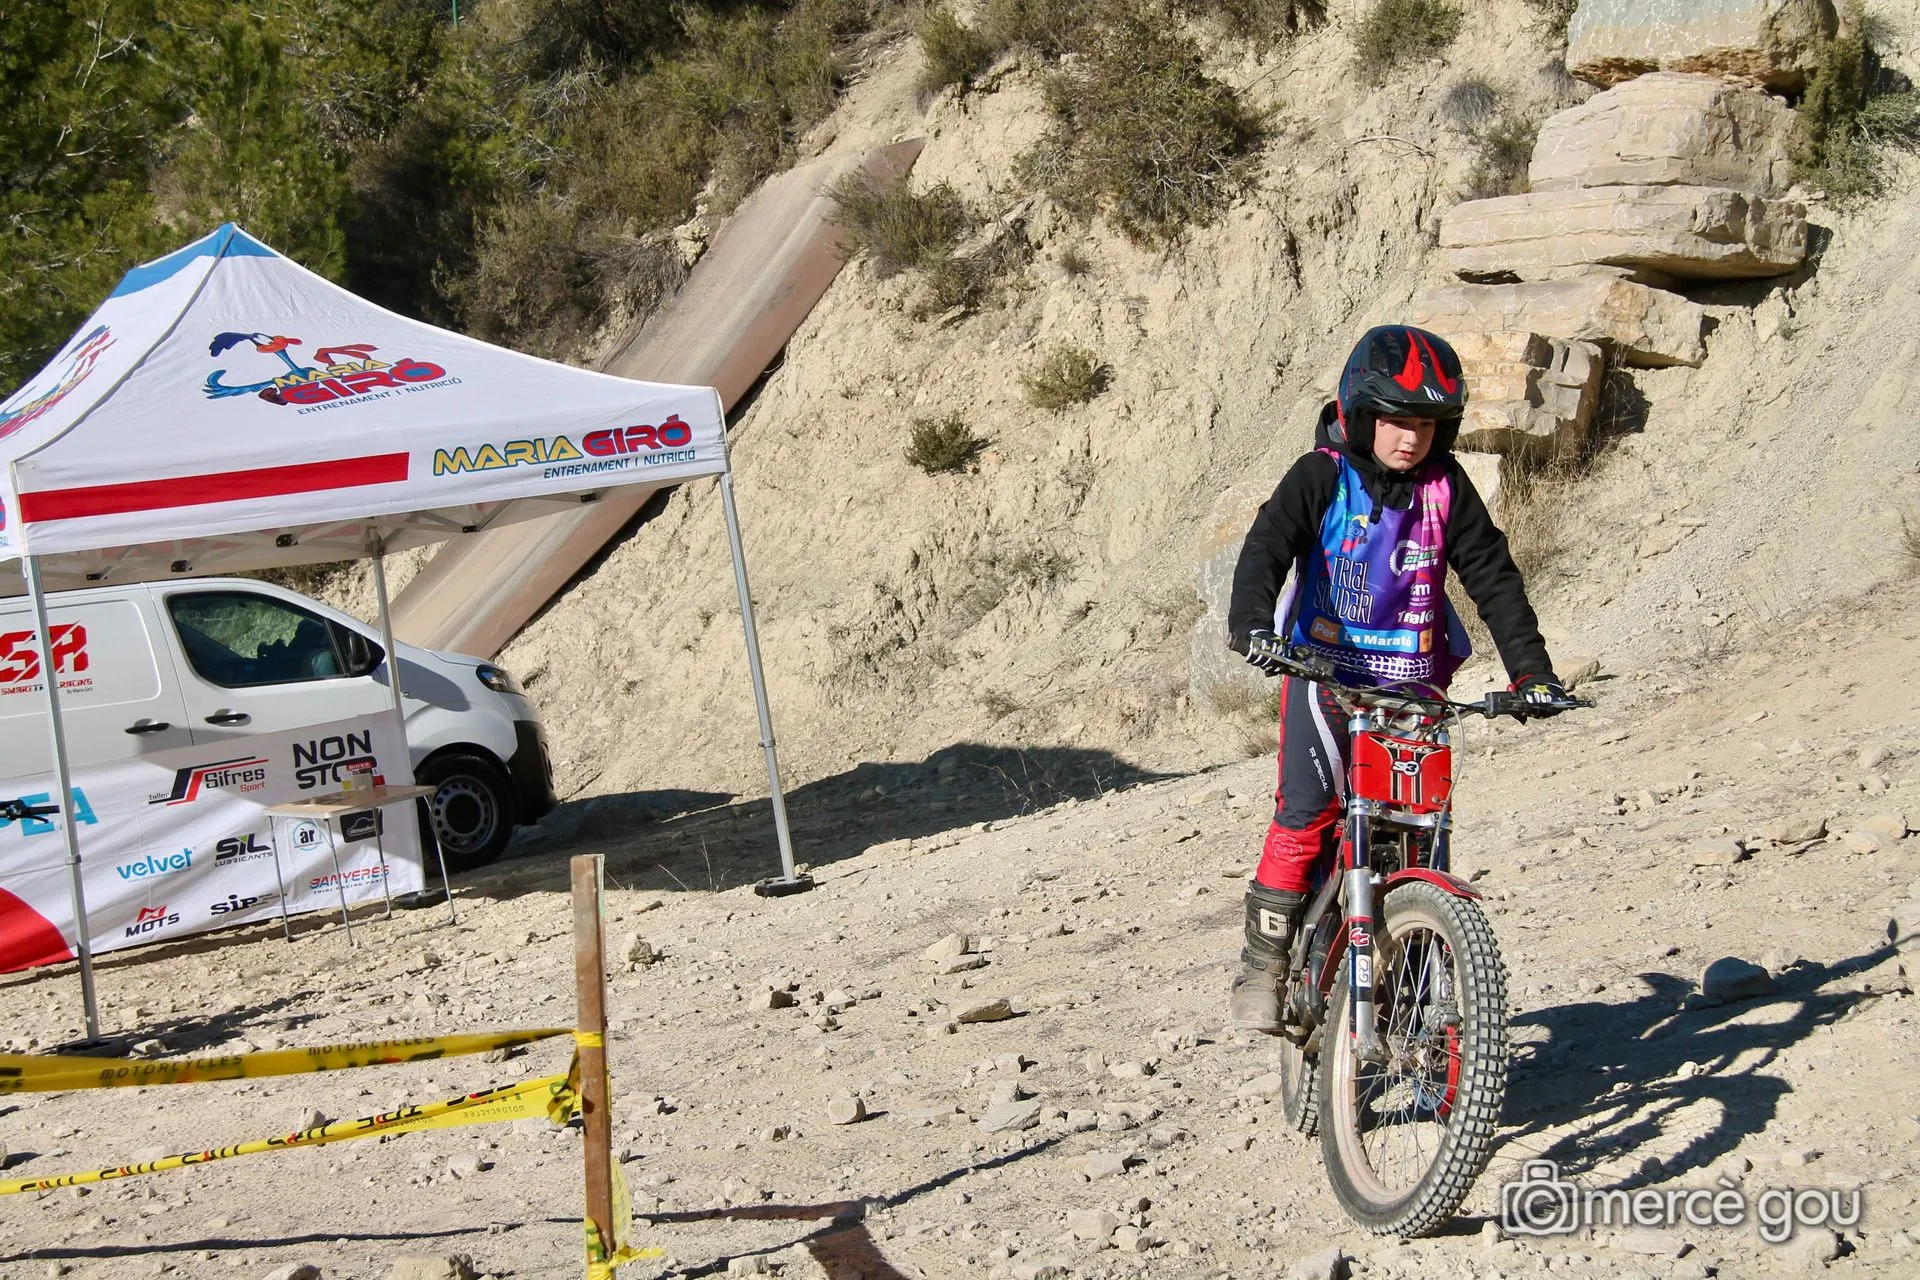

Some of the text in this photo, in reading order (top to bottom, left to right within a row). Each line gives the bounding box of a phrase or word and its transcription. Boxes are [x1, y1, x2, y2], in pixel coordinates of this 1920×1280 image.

[273, 359, 392, 388] MARIA
[297, 391, 392, 415] ENTRENAMENT
[406, 376, 463, 394] NUTRICIÓ
[433, 413, 693, 476] MARIA GIRÓ
[543, 457, 630, 479] ENTRENAMENT
[643, 446, 696, 466] NUTRICIÓ
[1314, 622, 1335, 638] Per
[1344, 632, 1412, 648] La Marató
[292, 729, 372, 768] NON
[204, 767, 265, 789] Sifres
[240, 781, 265, 793] Sport
[1313, 758, 1329, 792] SPECIAL
[116, 848, 193, 880] velvet
[215, 851, 274, 867] LUBRICANTS
[309, 865, 390, 890] BANYERES
[125, 912, 180, 938] MOTS
[100, 1055, 243, 1080] MOTORCYCLES
